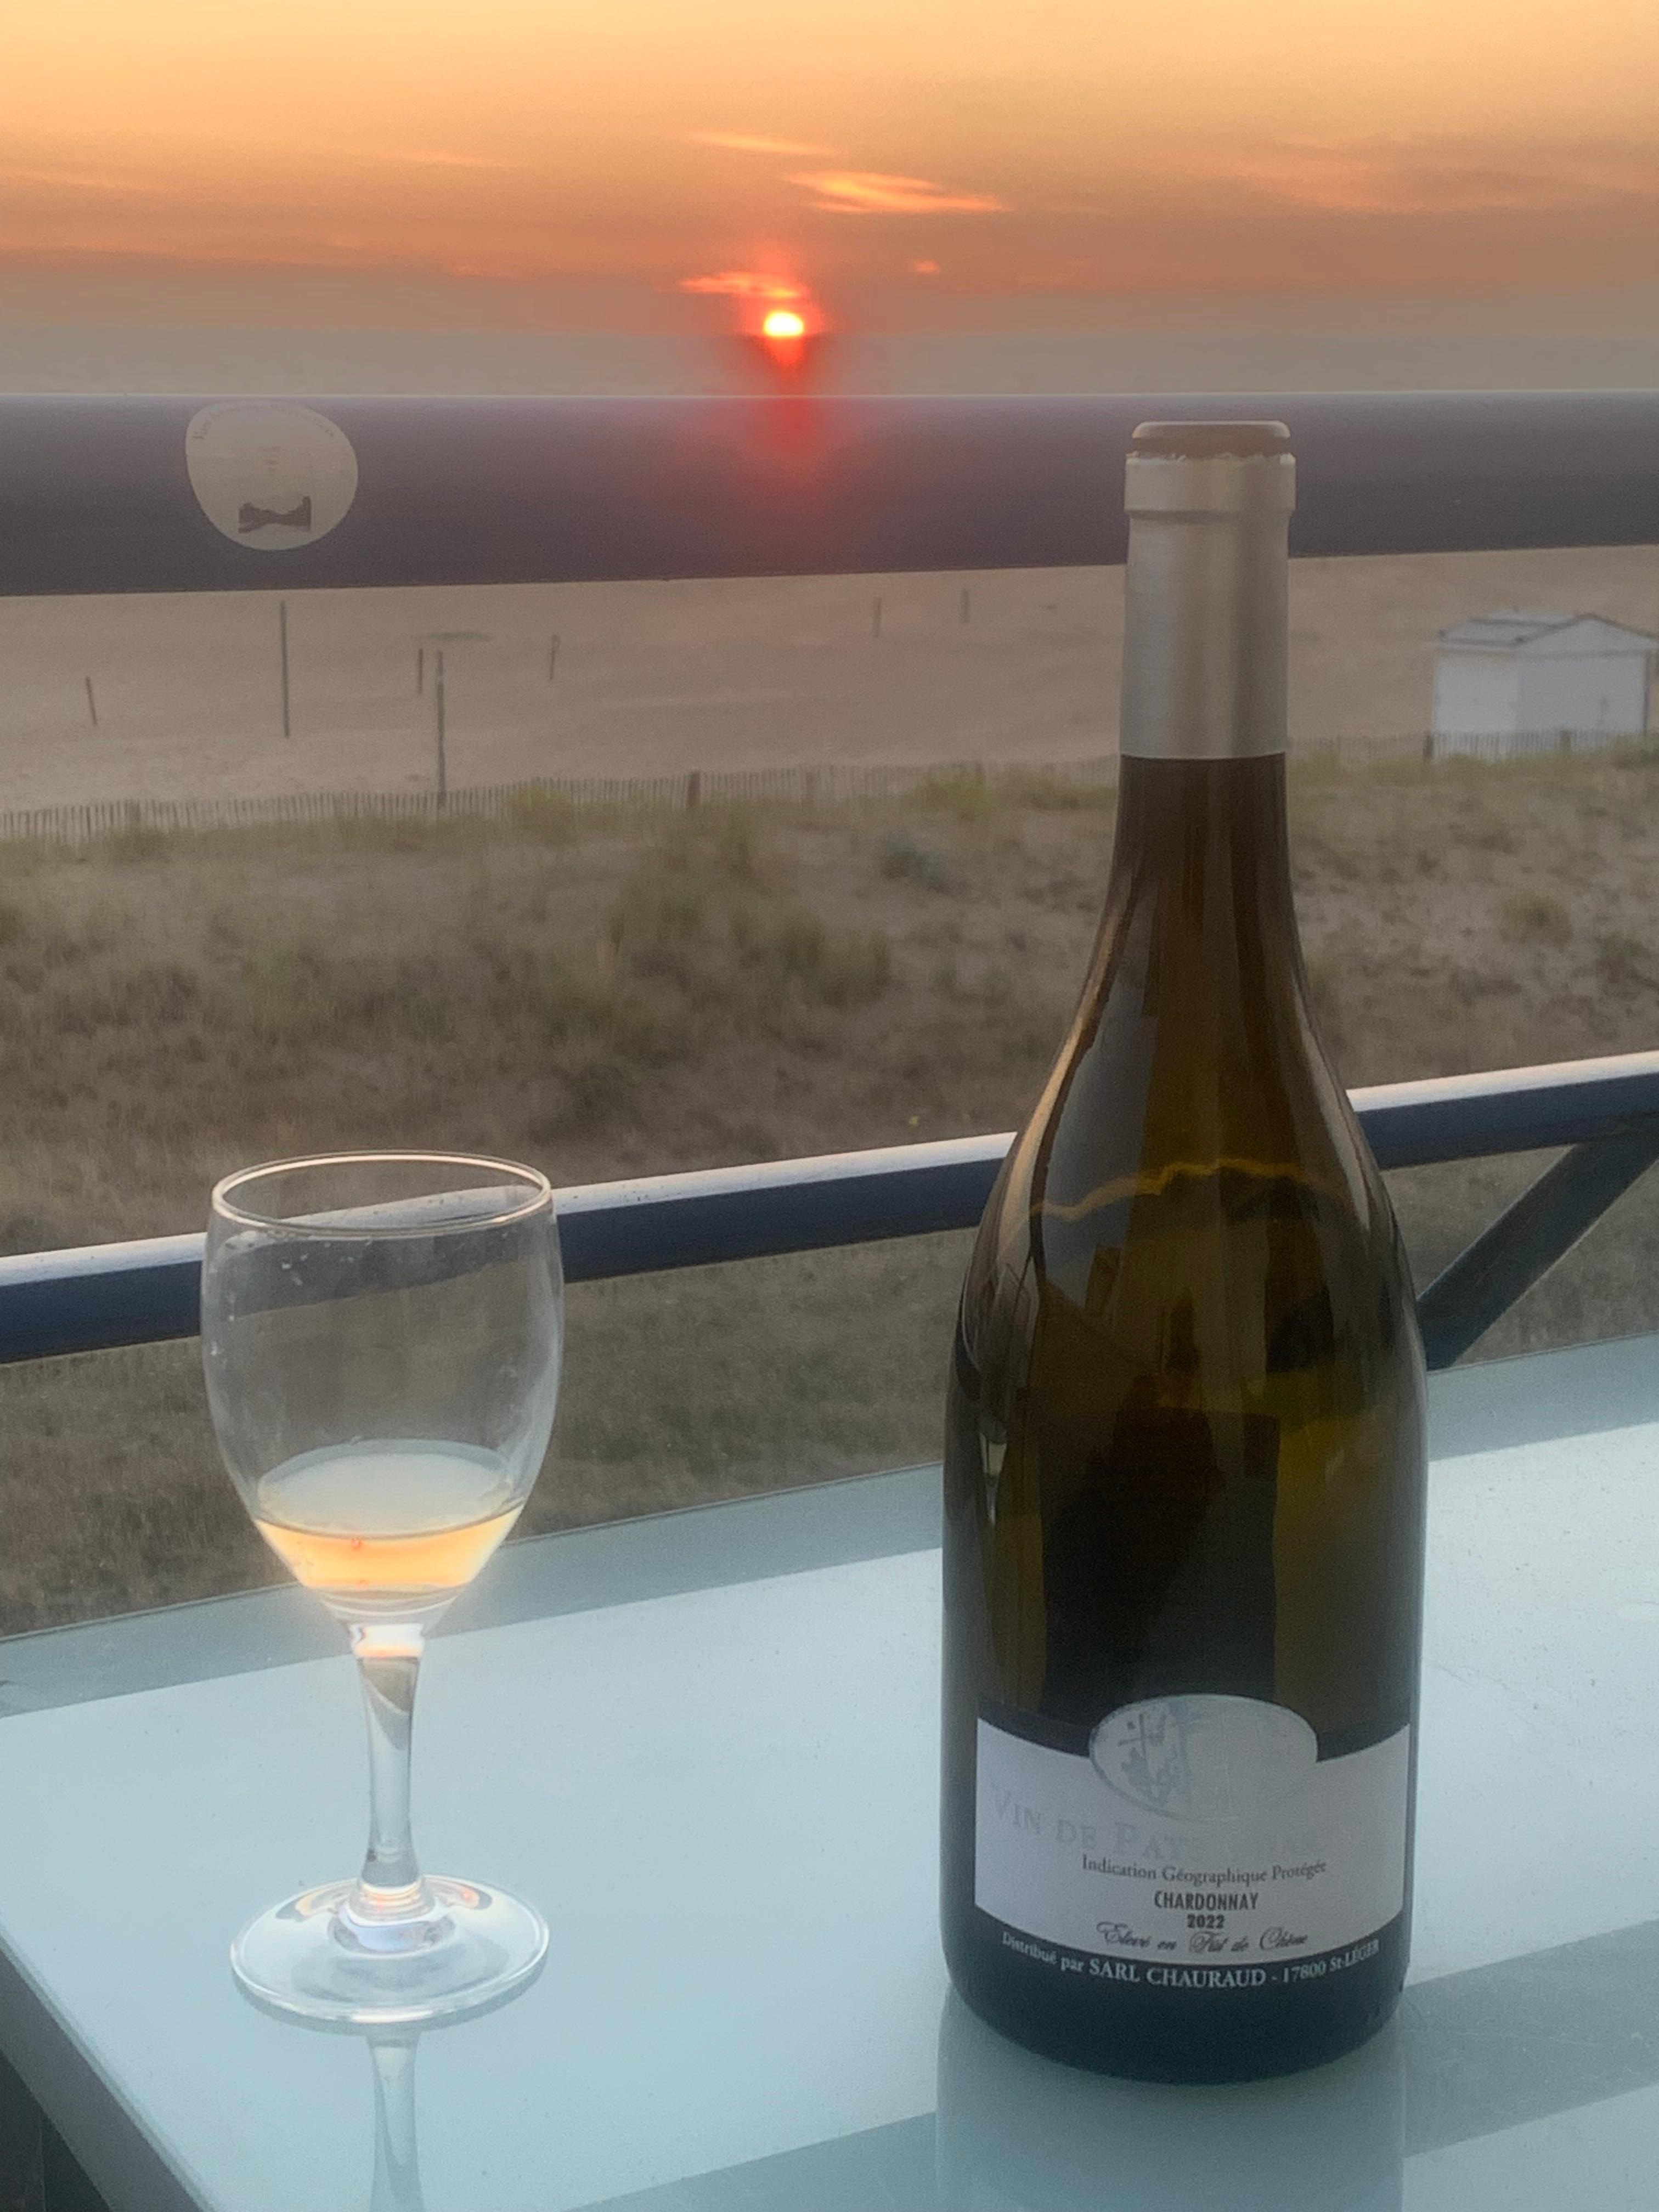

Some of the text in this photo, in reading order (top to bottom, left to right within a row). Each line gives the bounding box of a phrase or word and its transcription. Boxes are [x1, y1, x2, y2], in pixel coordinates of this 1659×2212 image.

[1082, 1853, 1326, 1887] Indication Géographique Protégée
[1154, 1891, 1259, 1910] CHARDONNAY
[1187, 1914, 1226, 1929] 2022
[1157, 1940, 1177, 1950] en
[1231, 1935, 1250, 1951] de
[1002, 1931, 1058, 1965] Distribué
[1060, 1956, 1085, 1972] par
[1088, 1958, 1141, 1982] SARL
[1146, 1967, 1267, 1988] CHAURAUD
[1283, 1960, 1327, 1983] 17800
